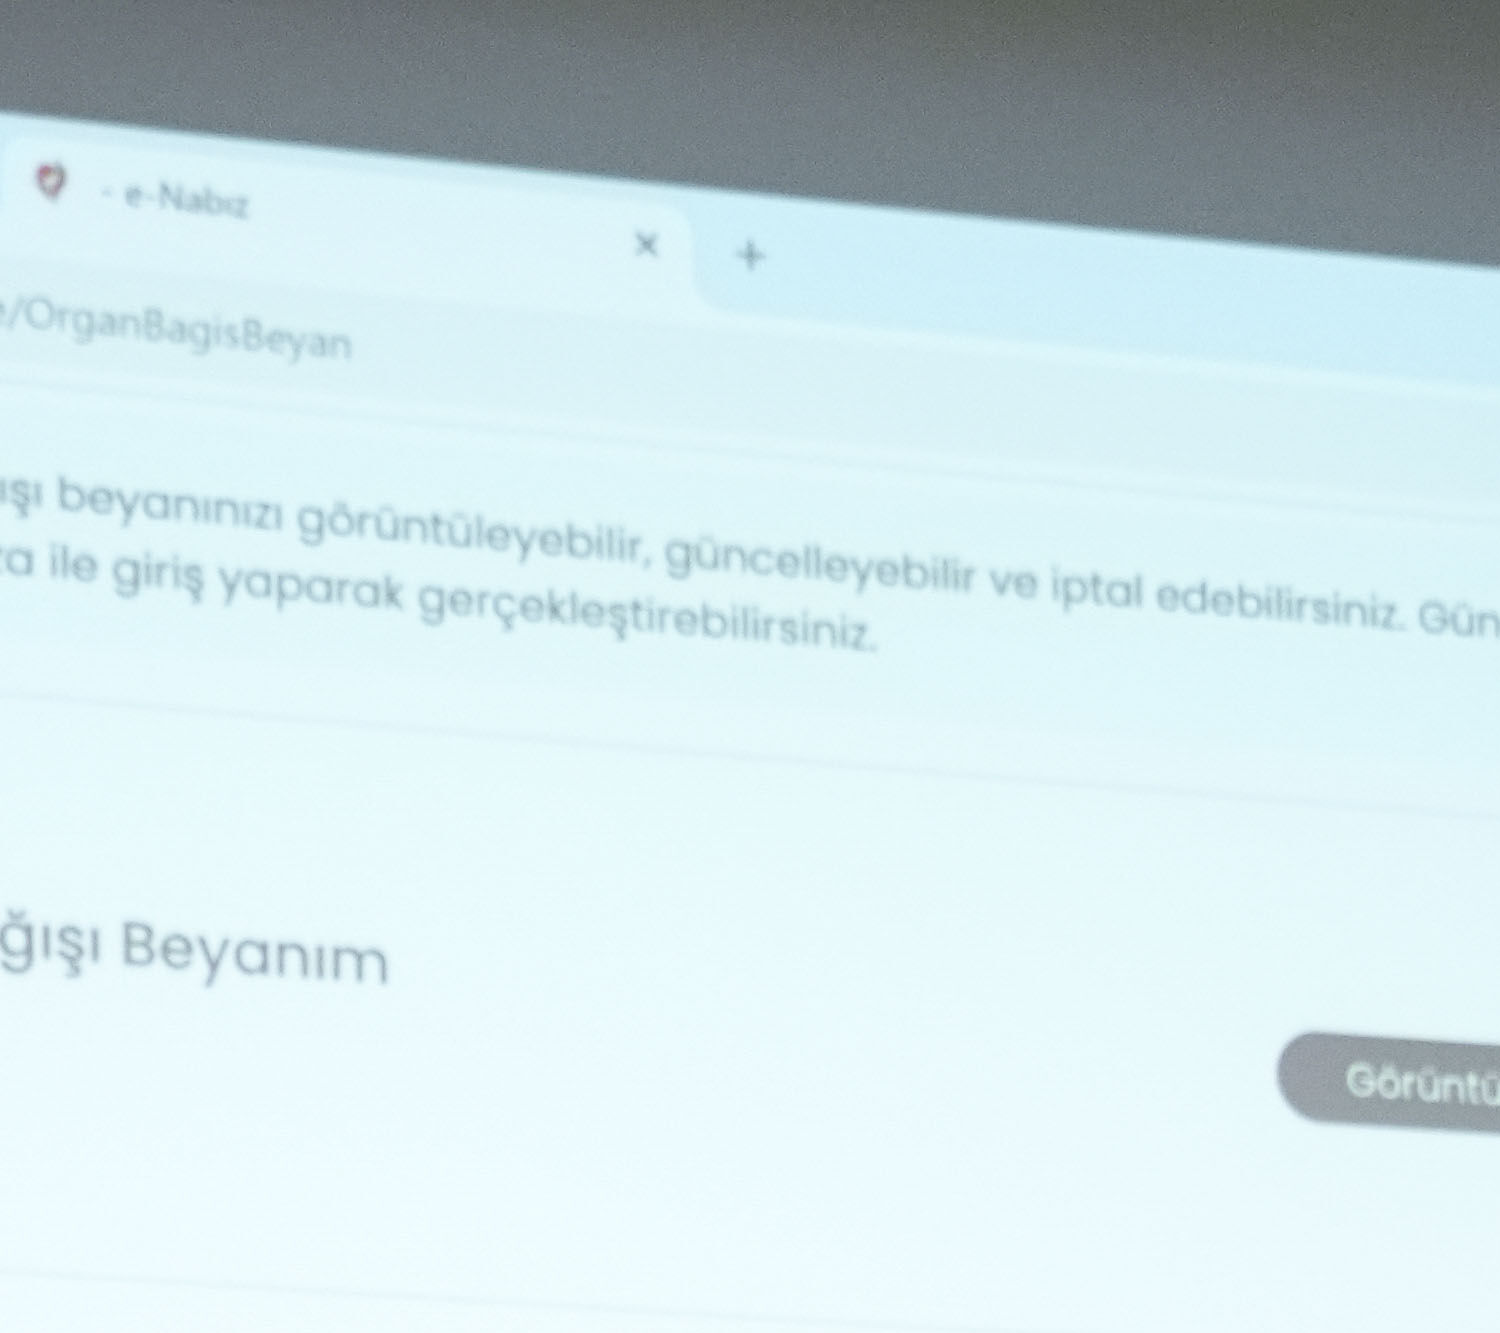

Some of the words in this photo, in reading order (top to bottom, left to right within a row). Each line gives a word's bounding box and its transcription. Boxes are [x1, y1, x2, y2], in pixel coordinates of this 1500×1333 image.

[48, 542, 100, 583] ile
[111, 551, 205, 604] giriş
[218, 562, 404, 614] yaparak
[418, 578, 880, 654] gerçekleştirebilirsiniz.
[57, 475, 284, 532] beyanınızı
[297, 500, 654, 570] görüntüleyebilir,
[664, 534, 977, 595] güncelleyebilir
[988, 568, 1039, 600] ve
[1050, 562, 1145, 615] iptal
[1156, 580, 1409, 633] edebilirsiniz.
[120, 918, 391, 989] Beyanım
